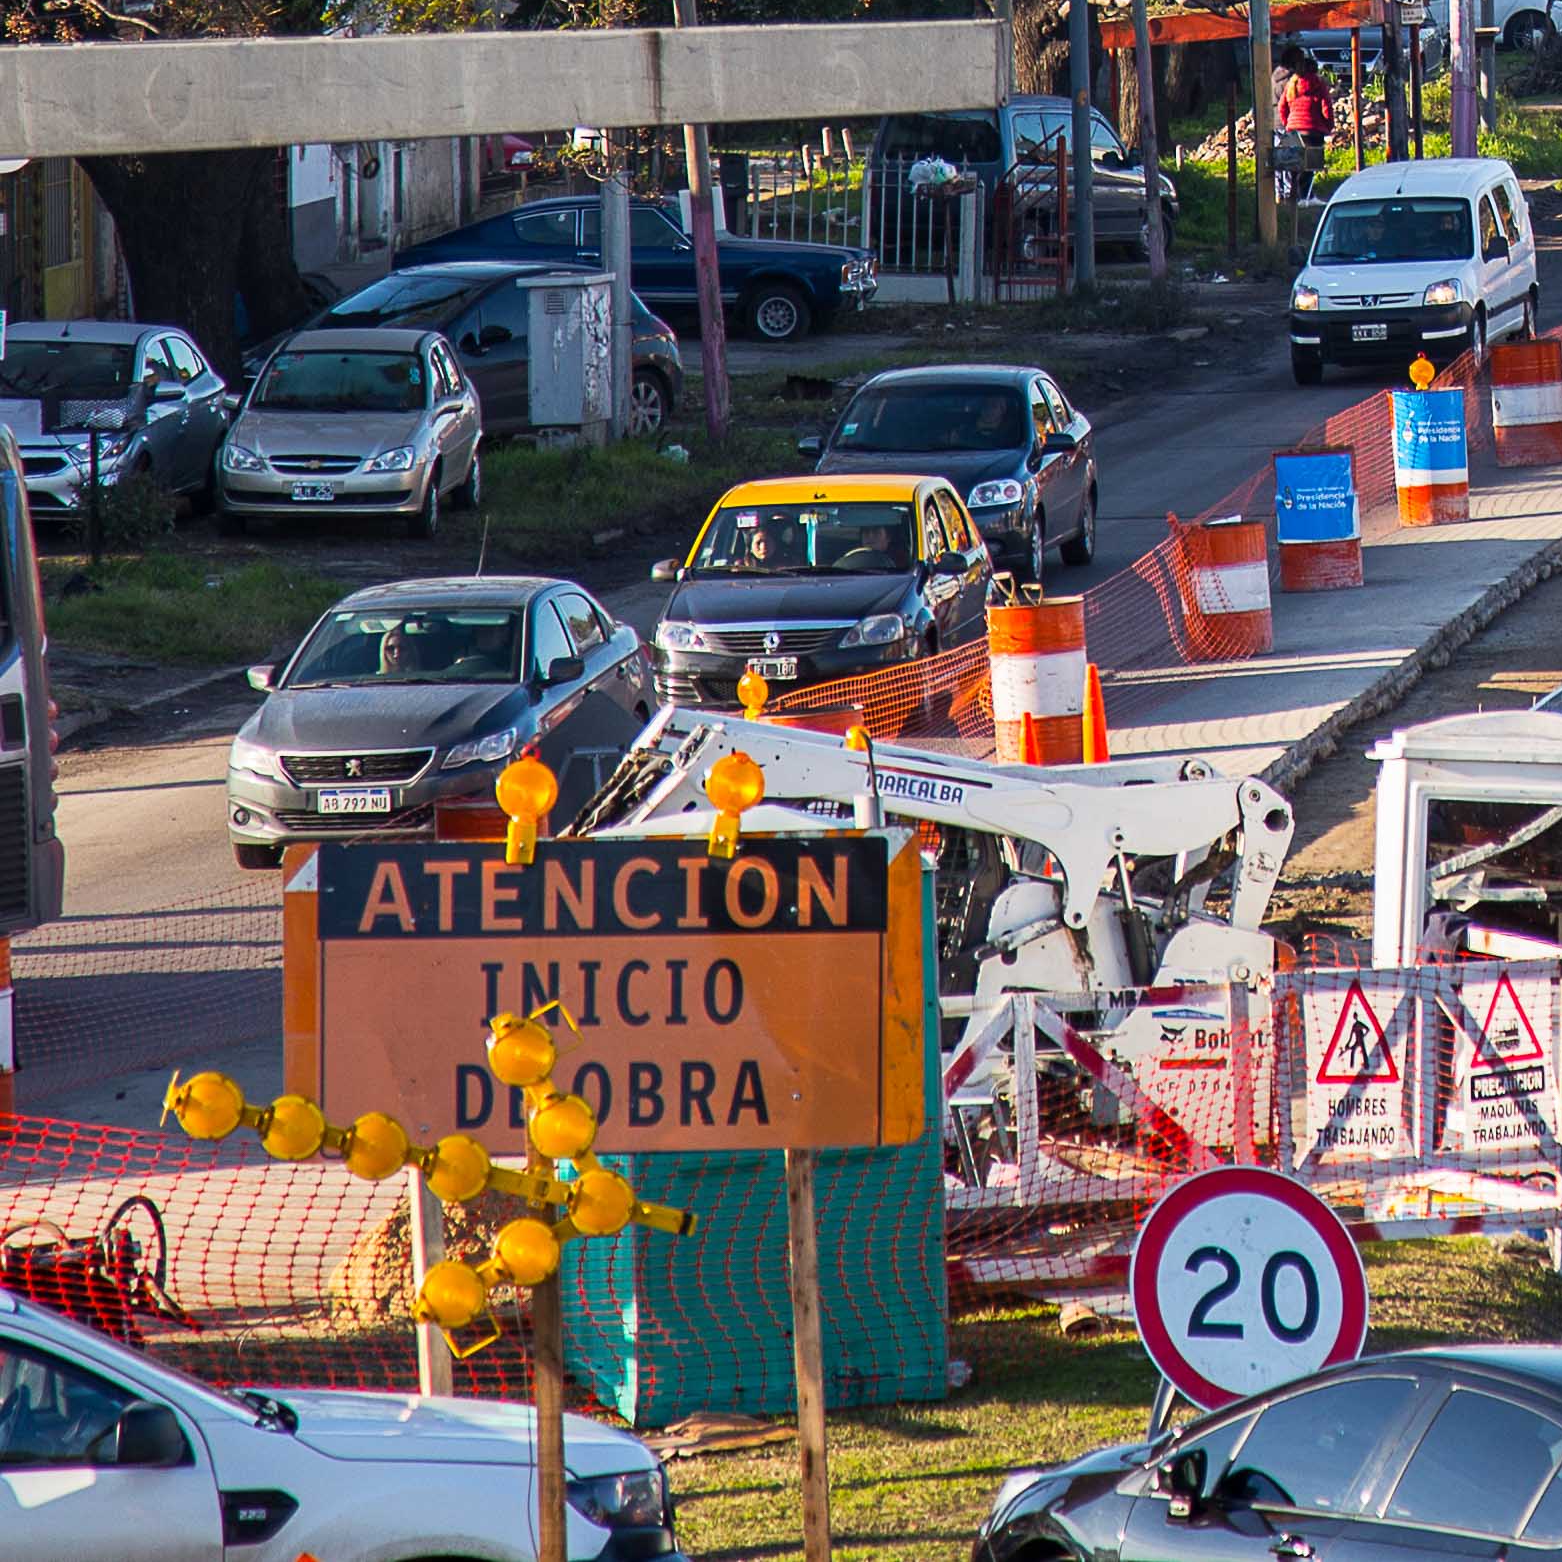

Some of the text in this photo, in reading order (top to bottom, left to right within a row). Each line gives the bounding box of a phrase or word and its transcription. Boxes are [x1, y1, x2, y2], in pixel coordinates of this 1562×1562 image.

[866, 773, 963, 804] MARCALBA
[357, 853, 851, 934] ATENCION
[479, 958, 746, 1028] INICIO
[571, 1059, 771, 1129] OBRA
[1328, 1097, 1387, 1117] HOMBRES
[1316, 1126, 1396, 1147] TRABAJANDO
[1472, 1119, 1547, 1144] TRABAJANDO
[1183, 1244, 1320, 1344] 20
